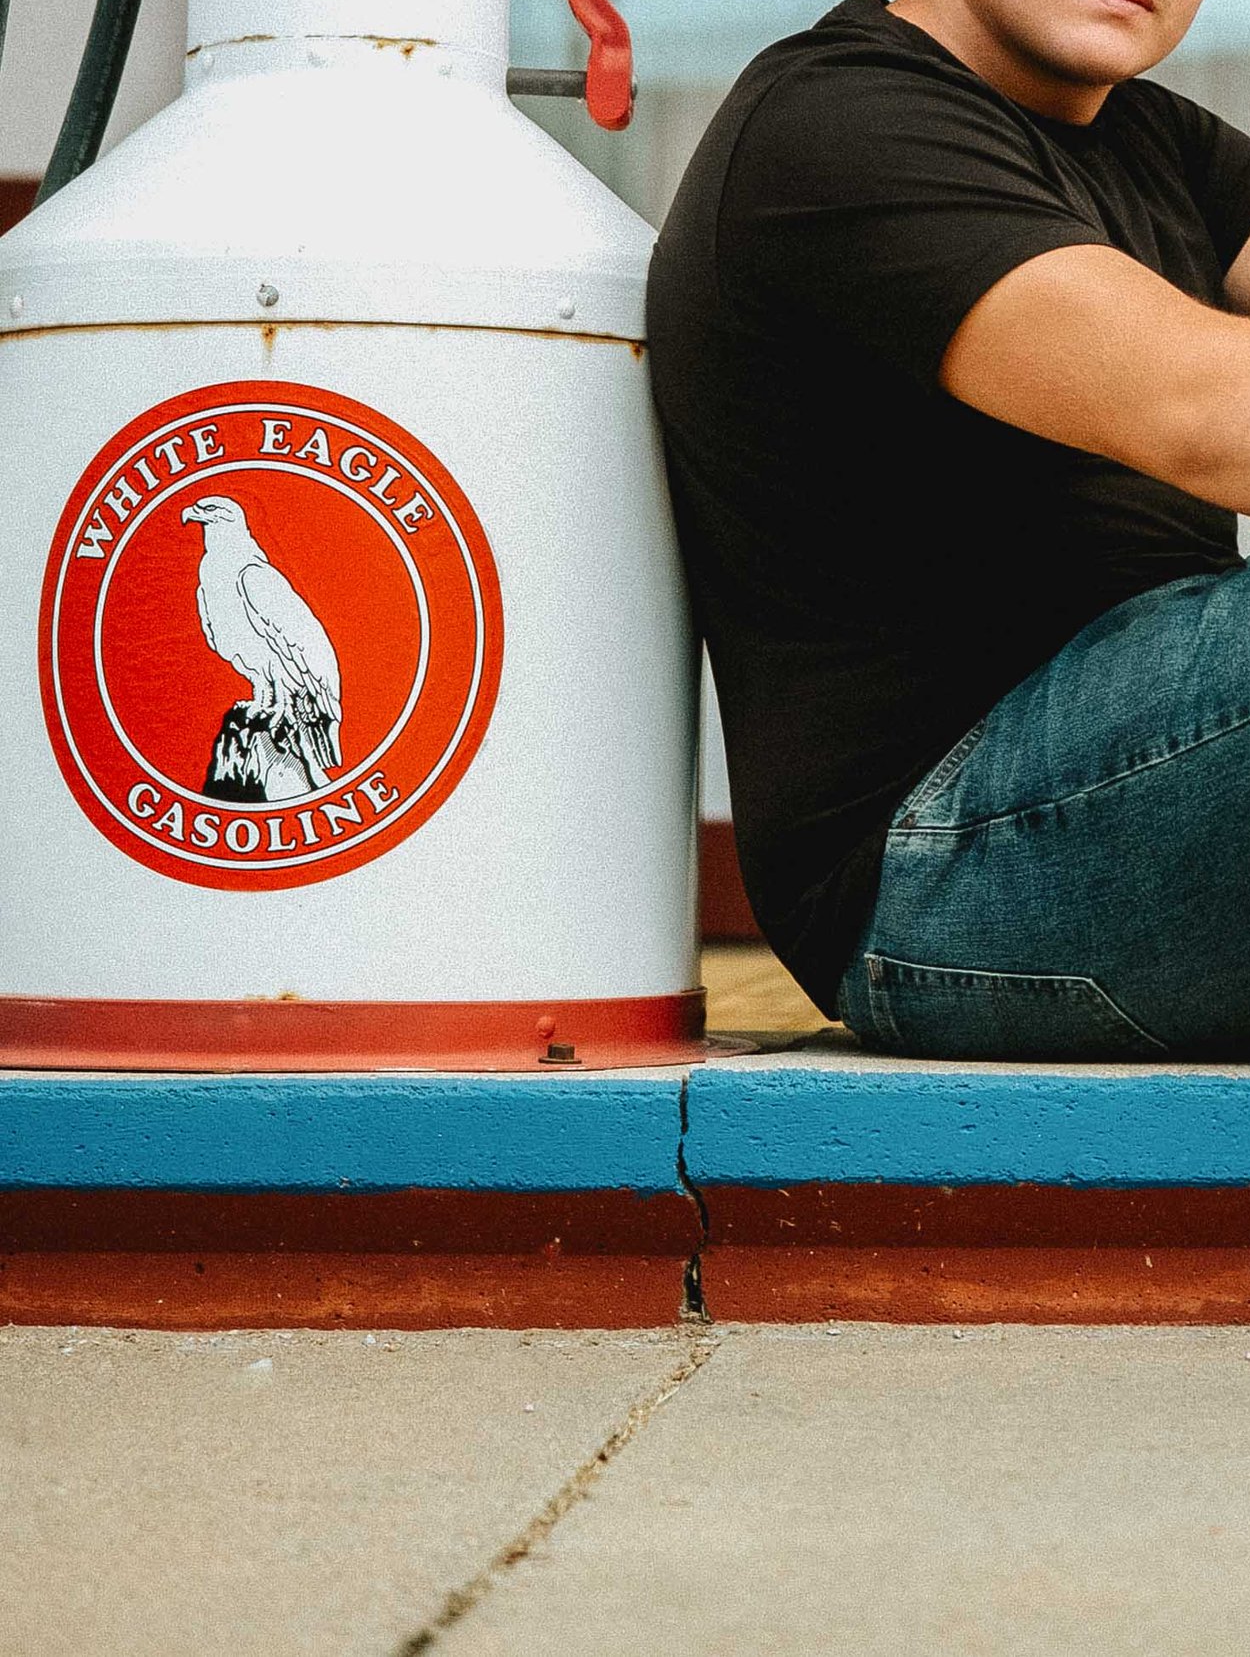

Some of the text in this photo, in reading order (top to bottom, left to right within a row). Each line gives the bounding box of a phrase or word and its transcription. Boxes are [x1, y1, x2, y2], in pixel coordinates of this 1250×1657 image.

[75, 418, 434, 560] WHITE EAGLE
[126, 771, 400, 854] GASOLINE
